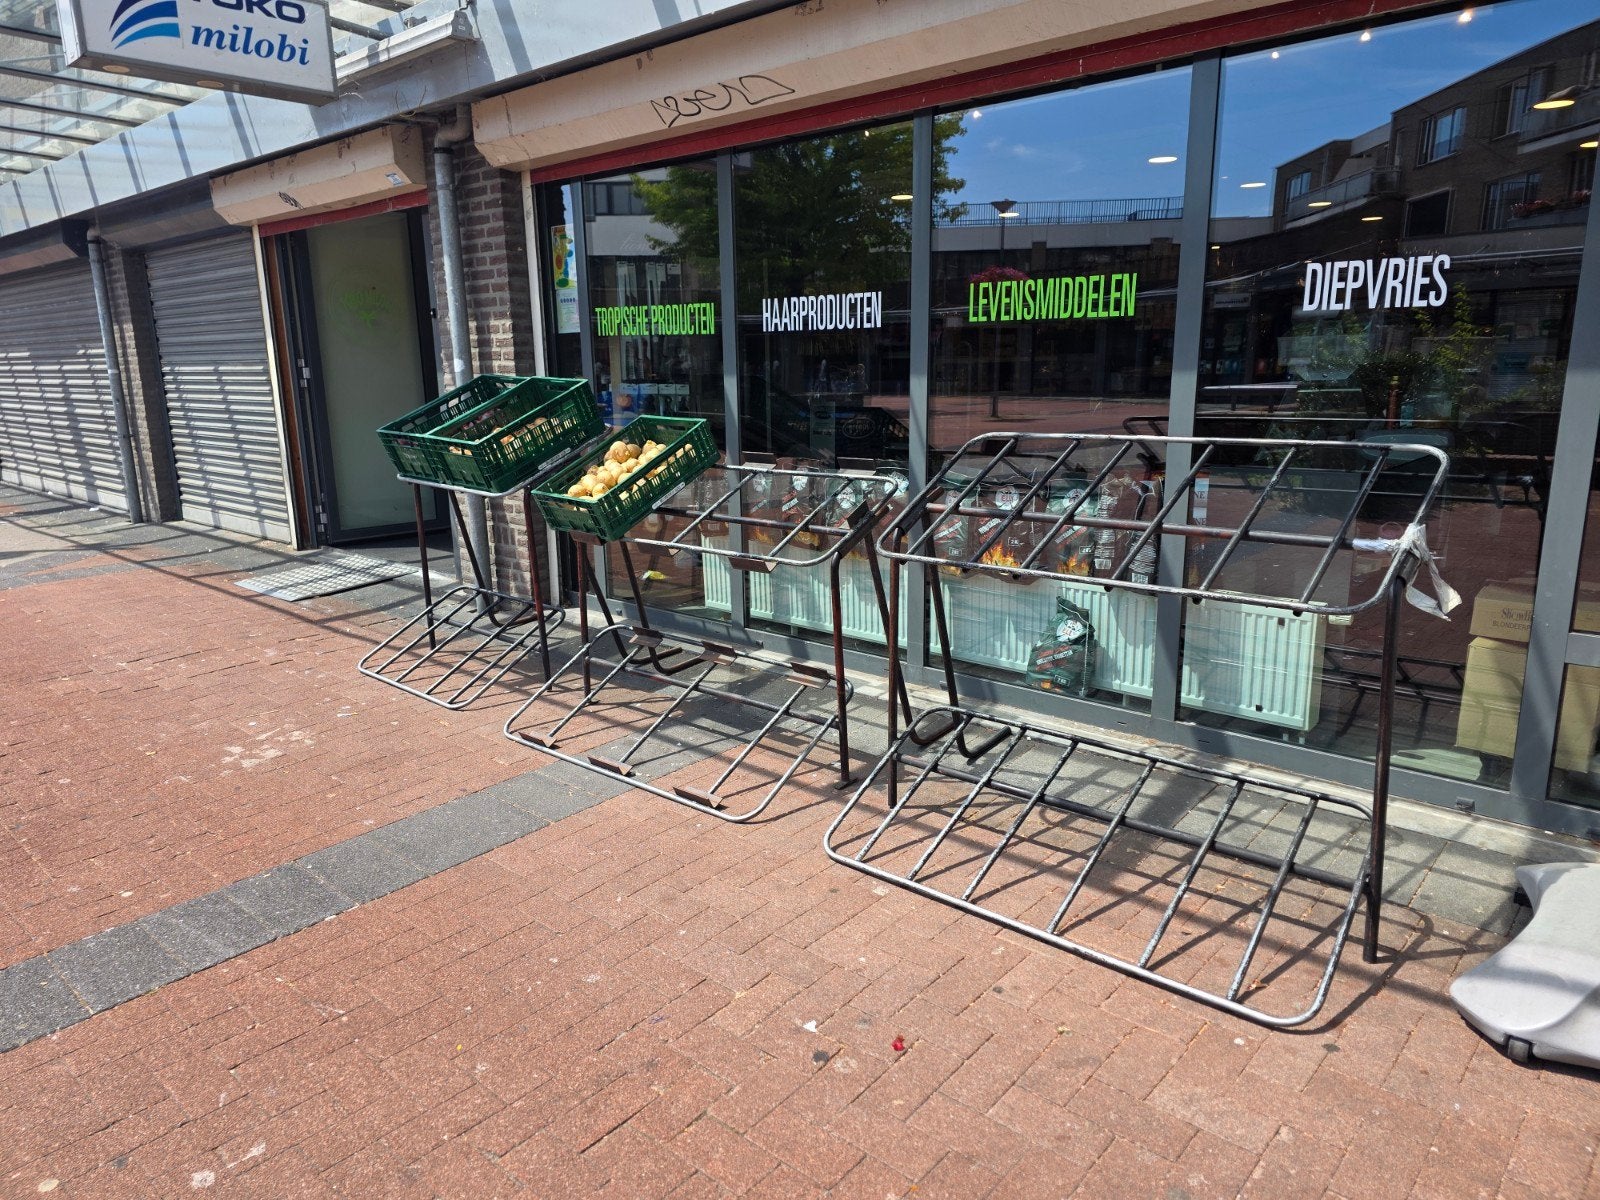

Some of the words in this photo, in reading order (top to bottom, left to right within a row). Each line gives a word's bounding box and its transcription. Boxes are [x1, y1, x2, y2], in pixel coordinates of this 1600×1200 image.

[191, 24, 310, 65] milobi
[968, 272, 1138, 322] LEVENSMIDDELEN
[1302, 254, 1451, 312] DIEPVRIES
[595, 305, 649, 336] TROPISCHE
[651, 302, 715, 335] PRODUCTEN
[762, 291, 882, 332] HAARPRODUCTEN
